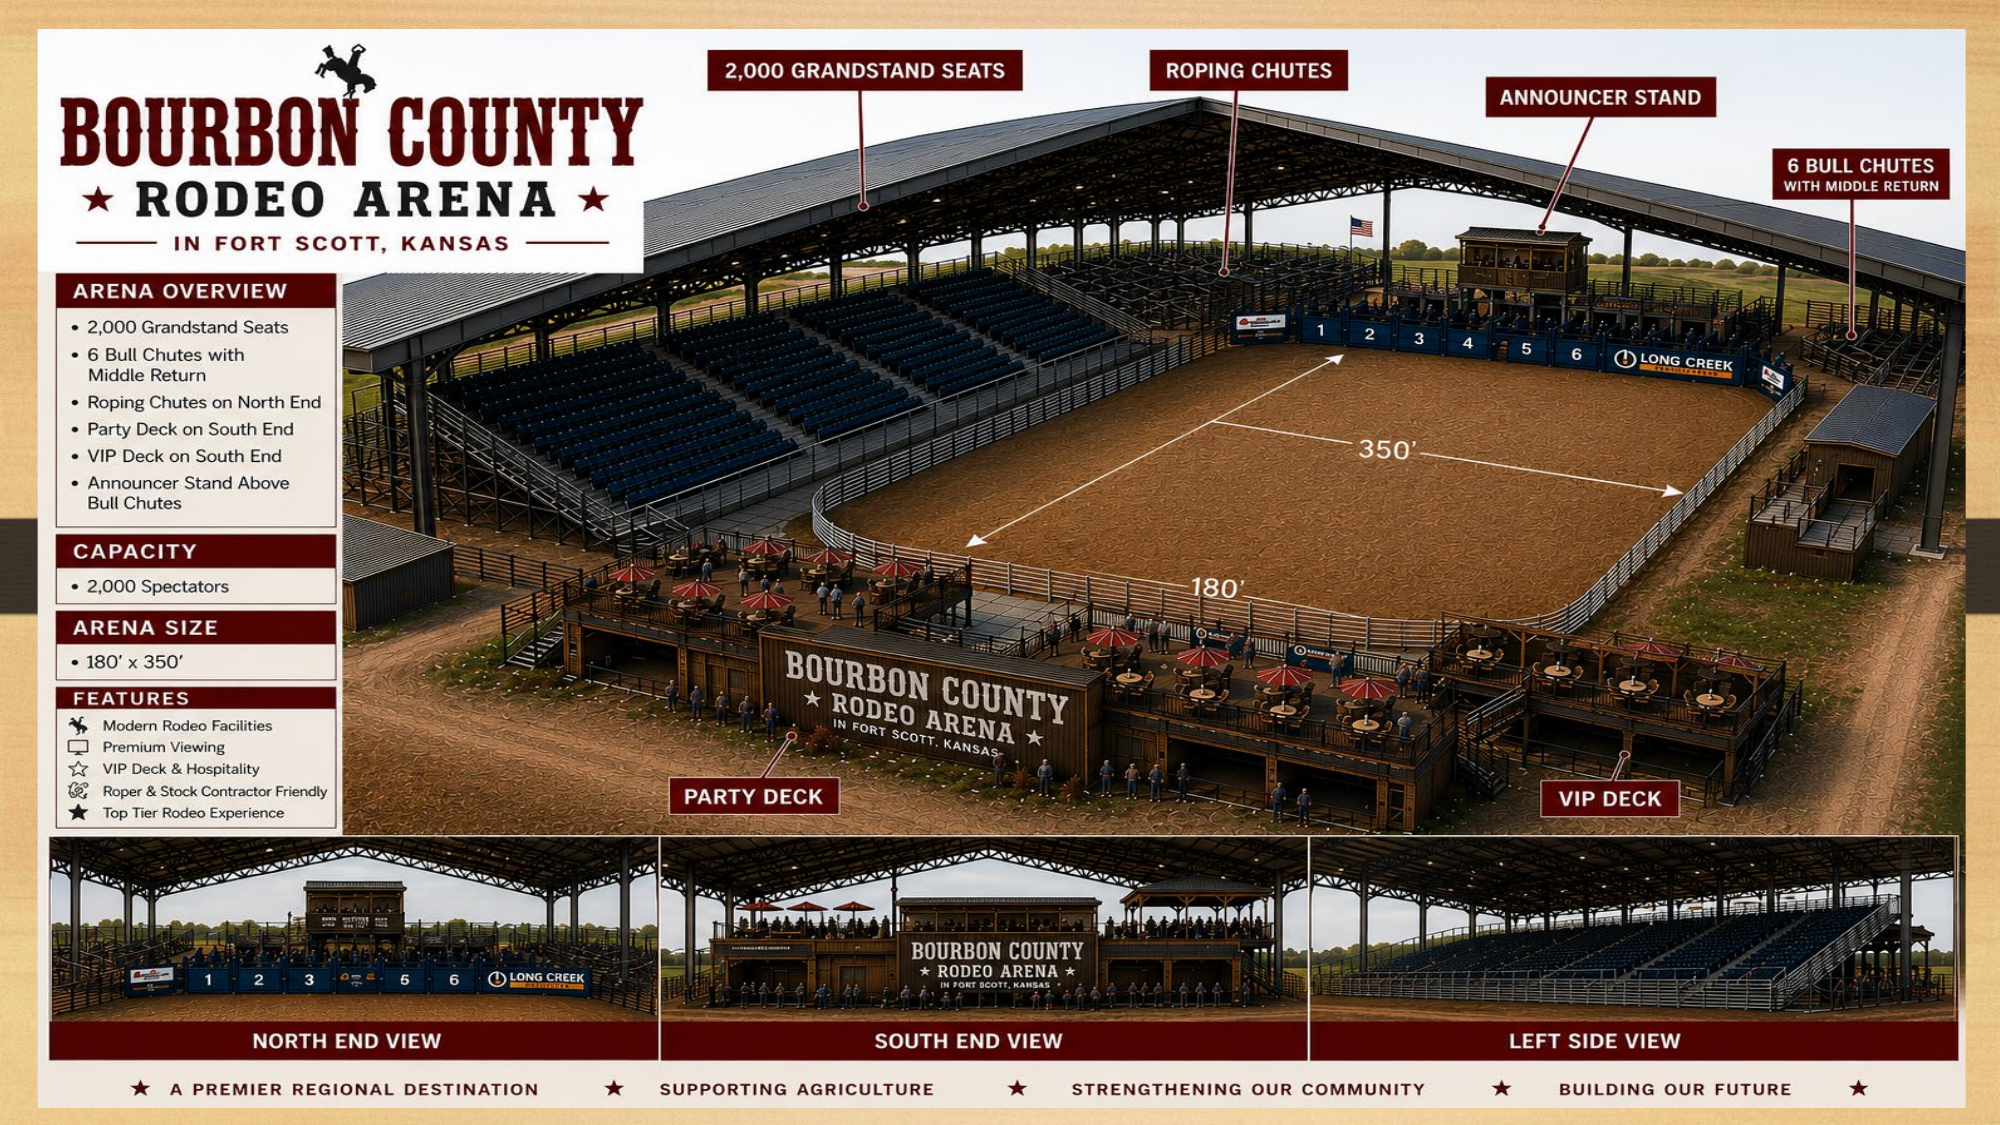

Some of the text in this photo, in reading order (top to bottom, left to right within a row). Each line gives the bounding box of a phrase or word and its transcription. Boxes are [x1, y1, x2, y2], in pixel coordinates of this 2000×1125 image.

[725, 62, 1005, 82] 2,000 GRANDSTAND SEATS
[1166, 62, 1333, 79] ROPING CHUTES
[1499, 89, 1702, 106] ANNOUNCER STAND
[60, 94, 644, 168] BOURBON COUNTY
[1787, 157, 1935, 174] 6 BULL CHUTES
[1783, 180, 1939, 192] WITH MIDDLE RETURN
[135, 180, 556, 218] RODEO ARENA
[174, 235, 509, 254] IN FORT SCOTT, KANSAS
[72, 283, 287, 299] ARENA OVERVIEW
[87, 320, 289, 336] 2,000 Grandstand Seats
[1317, 324, 1324, 337] 1
[1364, 327, 1375, 341] 2
[1414, 332, 1425, 346] 3
[1462, 336, 1474, 350] 4
[87, 347, 245, 362] 6 Bull Chutes with
[1521, 341, 1532, 356] 5
[1571, 347, 1582, 362] 6
[1640, 352, 1681, 367] LONG
[1685, 356, 1734, 372] CREEK
[88, 367, 206, 382] Middle Return
[88, 395, 322, 413] Roping Chutes on North End
[88, 421, 294, 440] Party Deck on South End
[87, 448, 282, 463] VIP Deck on South End
[87, 475, 290, 490] Announcer Stand Above
[88, 495, 182, 510] Bull Chutes
[73, 543, 197, 560] CAPACITY
[87, 579, 230, 597] 2,000 Spectators
[72, 619, 218, 636] ARENA SIZE
[785, 650, 1069, 726] BOURBON COUNTY
[73, 691, 189, 706] FEATURES
[103, 719, 273, 732] Modern Rodeo Facilities
[832, 692, 1015, 745] RODEO ARENA
[833, 717, 847, 730] IN
[852, 721, 887, 738] FORT
[944, 738, 999, 757] KANSAS
[103, 741, 225, 756] Premium Viewing
[102, 762, 260, 778] VIP Deck & Hospitality
[103, 785, 328, 800] Roper & Stock Contractor Friendly
[684, 788, 823, 805] PARTY DECK
[1558, 790, 1662, 807] VIP DECK
[102, 806, 285, 821] Top Tier Rodeo Experience
[911, 941, 1084, 961] BOURBON COUNTY
[509, 972, 585, 983] LONG CREEK
[937, 964, 1059, 978] RODEO ARENA
[205, 973, 211, 986] 1
[254, 973, 264, 986] 2
[305, 973, 314, 986] 3
[449, 973, 460, 986] 6
[953, 981, 976, 989] FORT
[253, 1032, 442, 1049] NORTH END VIEW
[875, 1032, 1063, 1050] SOUTH END VIEW
[1509, 1032, 1681, 1049] LEFT SIDE VIEW
[169, 1083, 538, 1096] A PREMIER REGIONAL DESTINATION
[660, 1083, 934, 1096] SUPPORTING AGRICULTURE
[1072, 1083, 1425, 1096] STRENGTHENING OUR COMMUNITY
[1559, 1083, 1791, 1096] BUILDING OUR FUTURE
